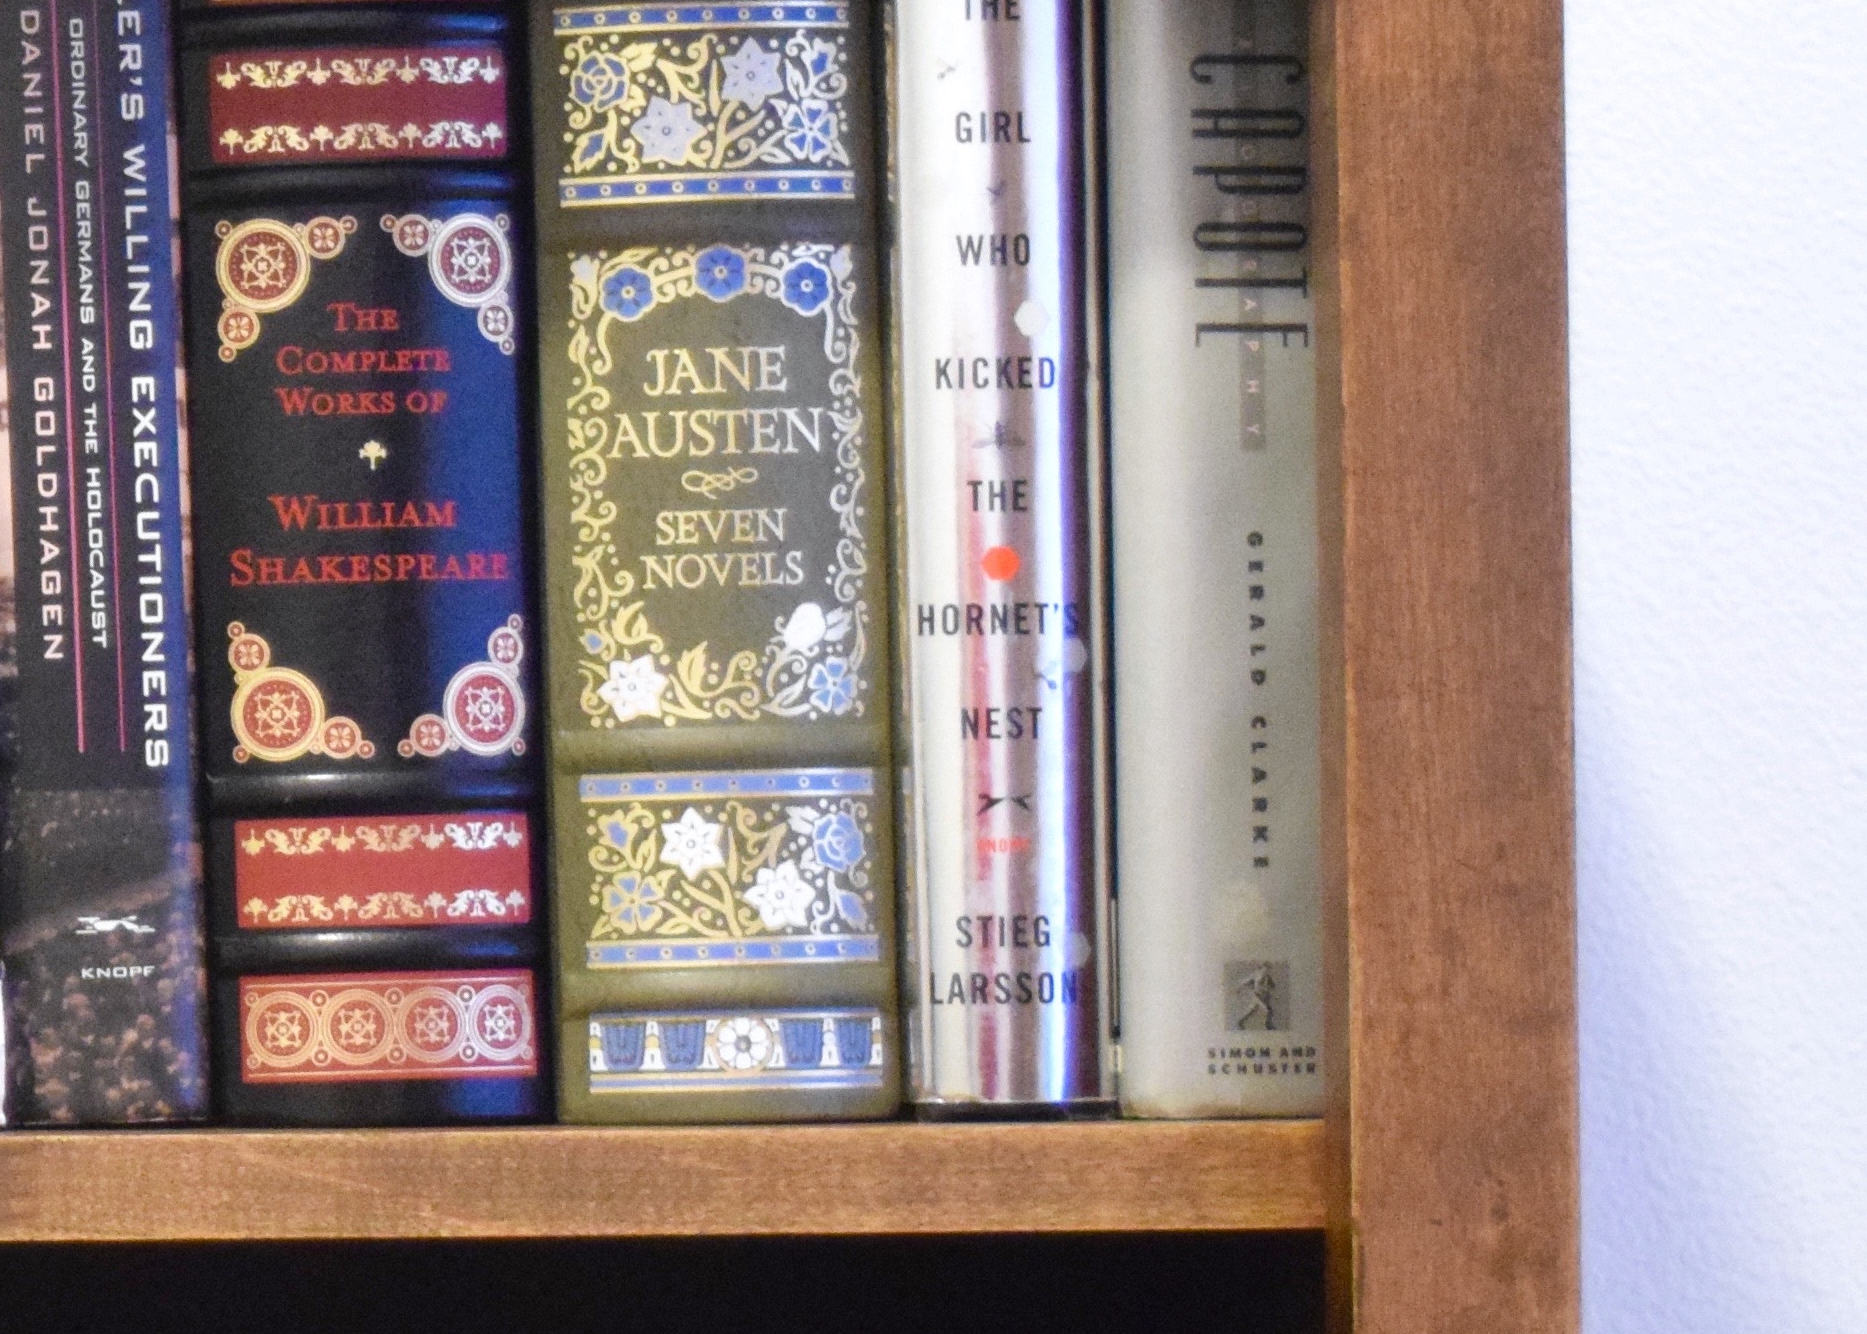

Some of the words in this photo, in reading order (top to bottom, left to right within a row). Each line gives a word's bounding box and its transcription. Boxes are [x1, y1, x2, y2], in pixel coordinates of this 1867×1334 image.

[956, 110, 1031, 145] GIRL
[957, 233, 1031, 266] WHO
[644, 346, 787, 397] JANE
[934, 356, 1056, 390] KICKED
[608, 410, 827, 458] AUSTEN
[968, 479, 1028, 513] THE
[656, 509, 786, 545] SEVEN
[641, 551, 804, 588] NOVELS
[917, 601, 1081, 637] HORNET'S
[961, 708, 1042, 741] NEST
[956, 913, 1052, 950] STIEG
[929, 970, 1080, 1006] LARSSON
